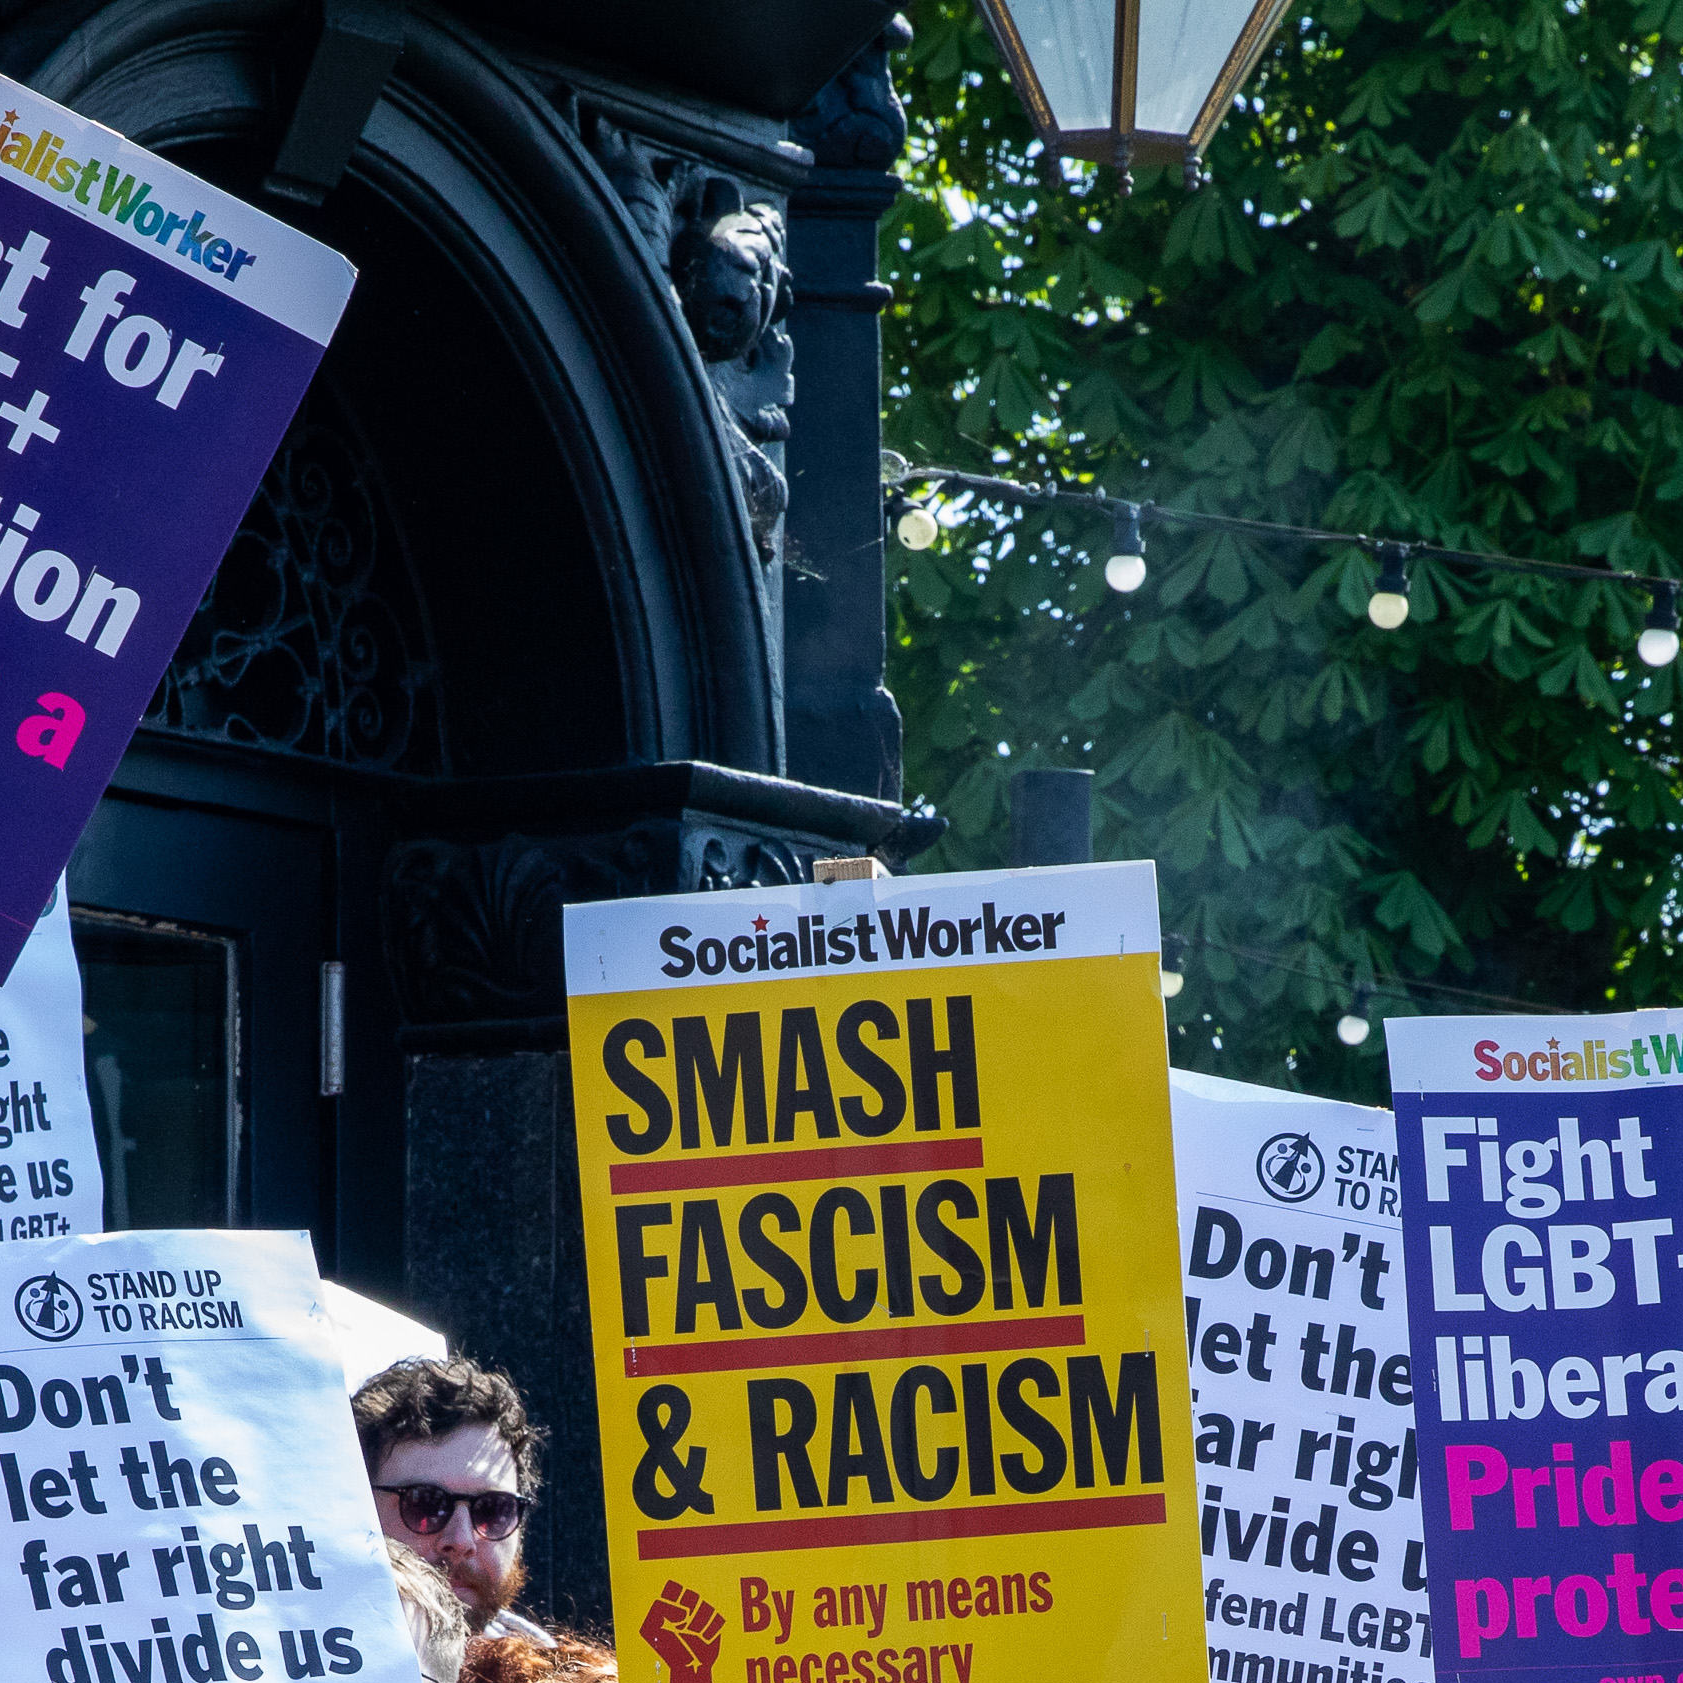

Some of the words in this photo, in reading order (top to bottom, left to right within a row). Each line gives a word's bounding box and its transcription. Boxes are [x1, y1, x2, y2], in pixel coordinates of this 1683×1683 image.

[64, 268, 225, 411] for
[16, 687, 88, 771] a
[603, 995, 981, 1155] SMASH
[27, 1159, 73, 1199] us
[1335, 1178, 1370, 1210] TO
[1422, 1117, 1656, 1219] Fight
[88, 1271, 176, 1301] STAND
[184, 1270, 221, 1297] UP
[615, 1173, 1082, 1337] FASCISM
[1189, 1206, 1390, 1310] Don't
[94, 1304, 132, 1332] TO
[138, 1301, 243, 1330] RACISM
[1185, 1296, 1277, 1382] let
[1300, 1322, 1413, 1406] the
[632, 1384, 714, 1520] &
[747, 1351, 1164, 1511] RACISM
[1191, 1389, 1275, 1472] ar
[1295, 1415, 1418, 1511] rig
[0, 1451, 107, 1522] let
[119, 1441, 240, 1510] the
[20, 1540, 129, 1610] far
[152, 1524, 322, 1610] right
[1201, 1484, 1379, 1582] ivide
[1401, 1539, 1428, 1593] u
[739, 1576, 795, 1645] By
[813, 1583, 888, 1639] any
[906, 1571, 1054, 1622] means
[1204, 1578, 1309, 1636] fend
[1320, 1597, 1433, 1658] LGBT
[279, 1627, 362, 1680] us
